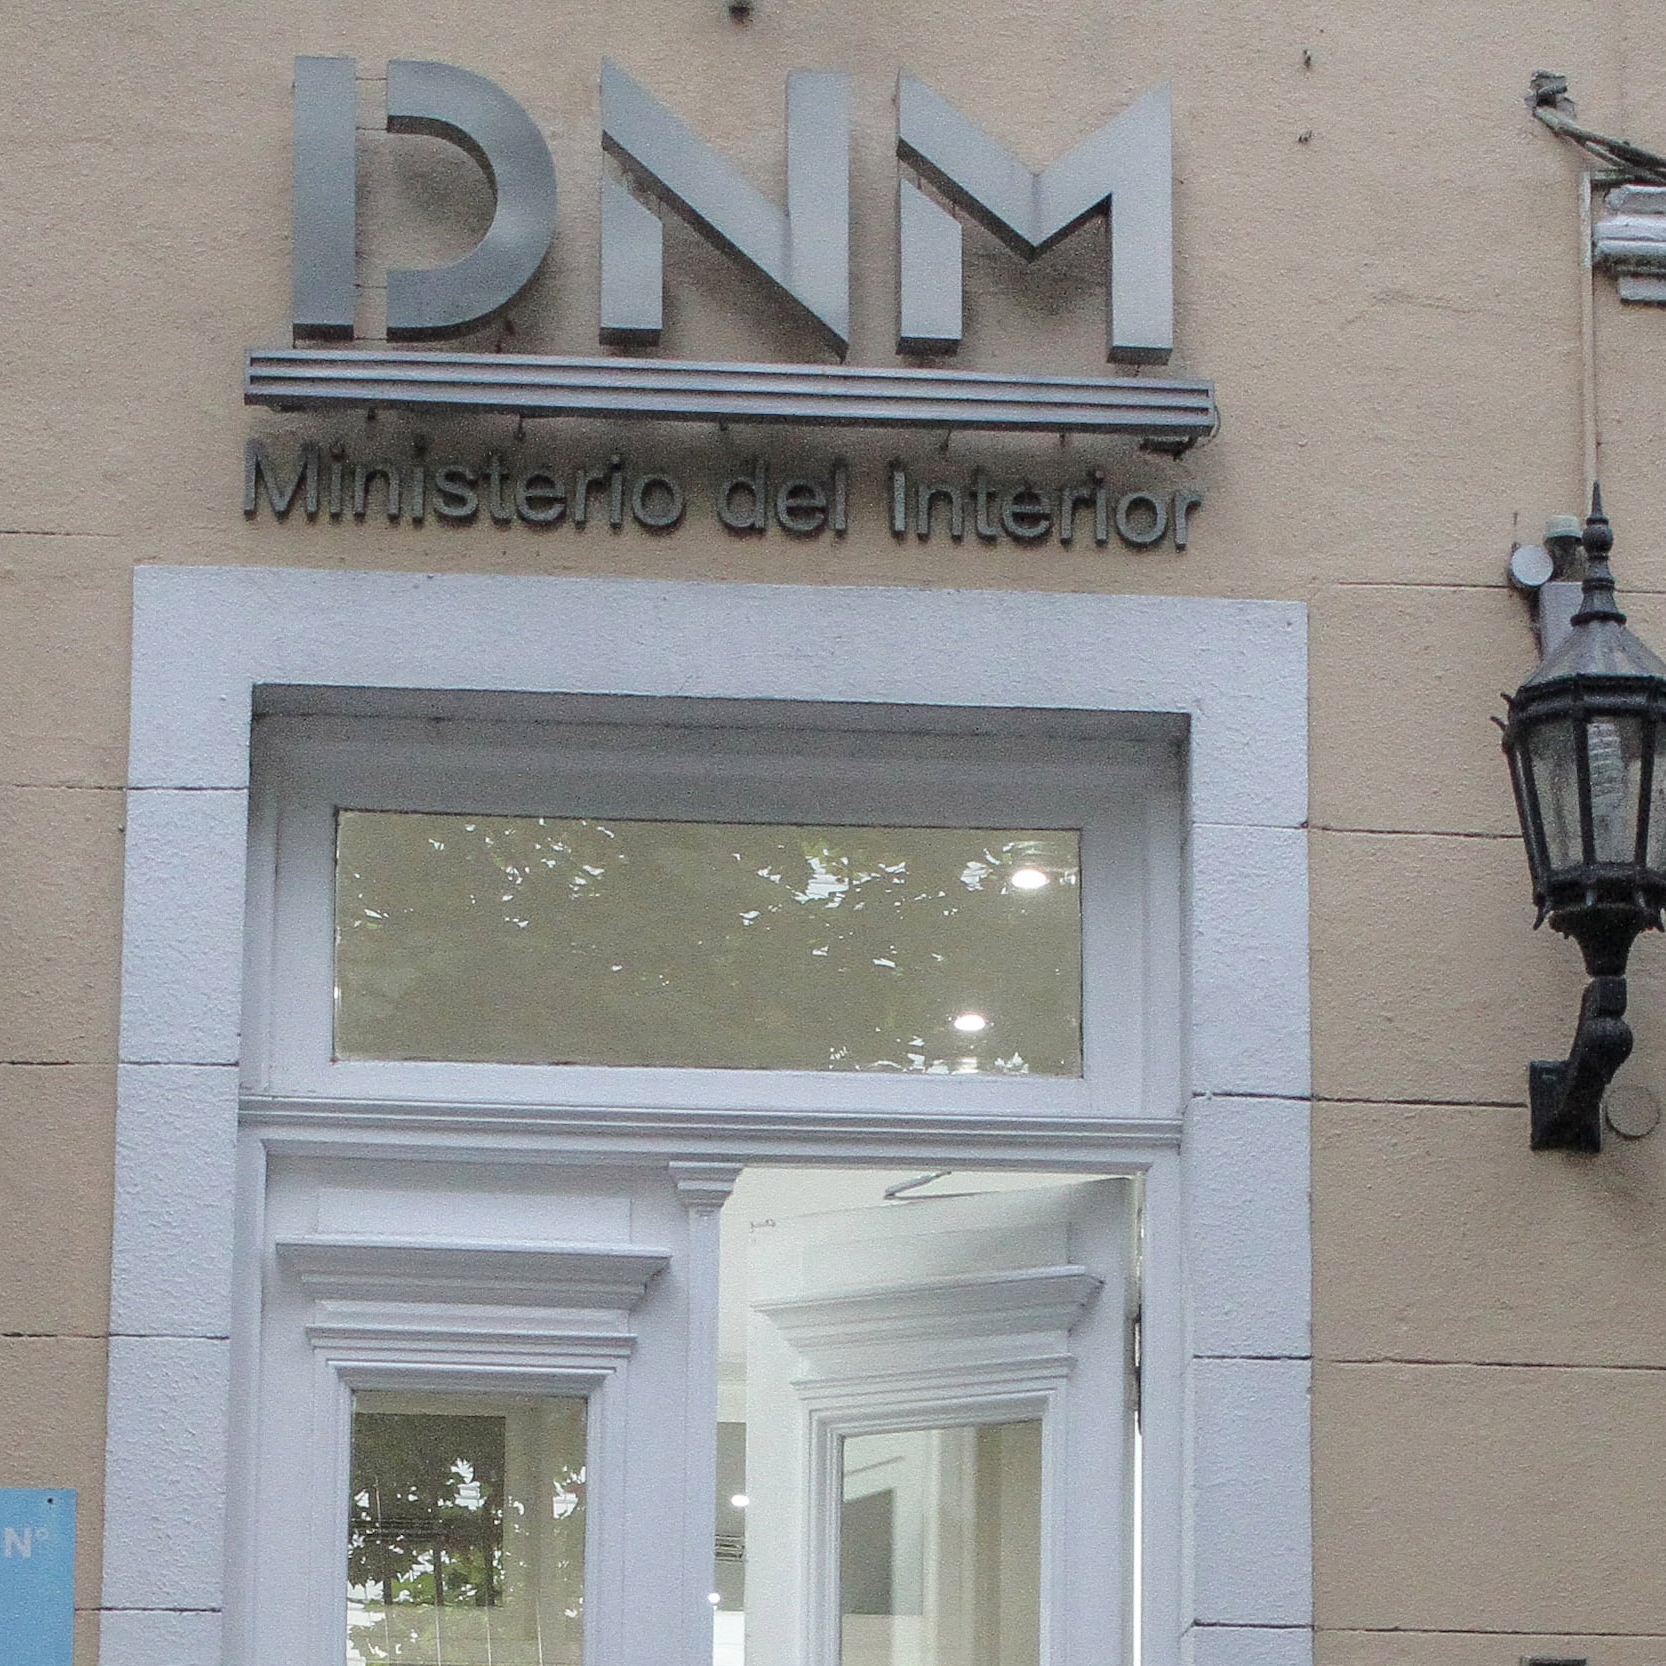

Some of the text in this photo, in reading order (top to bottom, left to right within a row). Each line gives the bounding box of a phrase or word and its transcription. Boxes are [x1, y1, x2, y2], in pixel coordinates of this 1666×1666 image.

[292, 55, 1174, 365] DNM
[243, 438, 1206, 550] Ministerio del Interior
